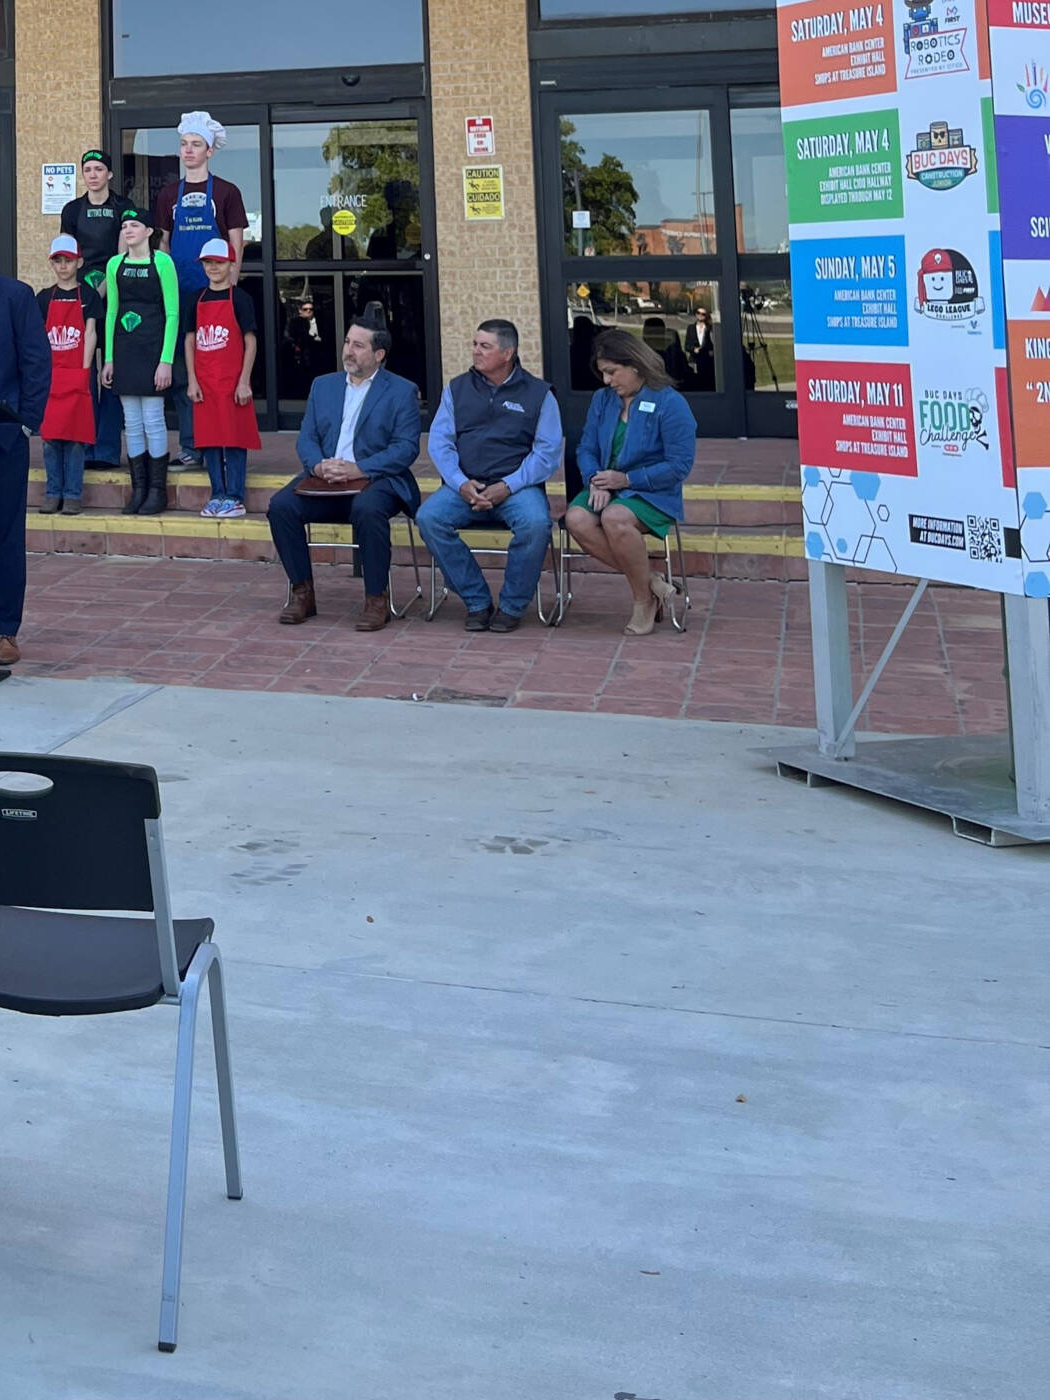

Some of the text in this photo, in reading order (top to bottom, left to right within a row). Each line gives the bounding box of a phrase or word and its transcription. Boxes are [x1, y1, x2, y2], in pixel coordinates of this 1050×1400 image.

[791, 4, 884, 42] SATURDAY, MAY 4
[822, 43, 848, 58] AMERICAN
[911, 33, 961, 52] ROBOTICS
[871, 50, 885, 63] HALL
[918, 49, 955, 66] RODEO
[832, 71, 839, 83] AT
[839, 67, 866, 81] TREASURE
[866, 63, 886, 77] ISLAND
[796, 128, 890, 161] SATURDAY, MAY 4
[914, 149, 968, 170] BUC DAYS
[466, 169, 499, 178] CAUTION
[829, 165, 855, 178] AMERICAN
[871, 162, 891, 175] CENTER
[839, 178, 852, 190] HALL
[866, 175, 892, 188] HALLWAY
[320, 194, 368, 208] ENTRANCE
[467, 193, 501, 202] CUIDADO
[873, 189, 885, 200] MAY
[886, 188, 893, 201] 12
[815, 255, 896, 282] SUNDAY, MAY 5
[834, 289, 861, 301] AMERICAN
[876, 288, 897, 301] CENTER
[883, 302, 897, 315] HALL
[927, 303, 971, 314] LEGO LEAGUE
[843, 315, 851, 328] AT
[851, 315, 878, 329] TREASURE
[878, 316, 898, 329] ISLAND
[808, 378, 904, 409] SATURDAY, MAY 11
[925, 390, 963, 400] BUC DAYS
[842, 413, 869, 427] AMERICAN
[886, 417, 906, 430] CENTER
[919, 401, 971, 431] FOOD
[893, 431, 908, 444] HALL
[920, 424, 976, 451] Challenge
[853, 441, 860, 454] AT
[860, 442, 888, 456] TREASURE
[888, 444, 909, 459] ISLAND
[912, 516, 963, 535] MORE INFORMATION
[920, 530, 964, 548] AT BUCDAYS.COM
